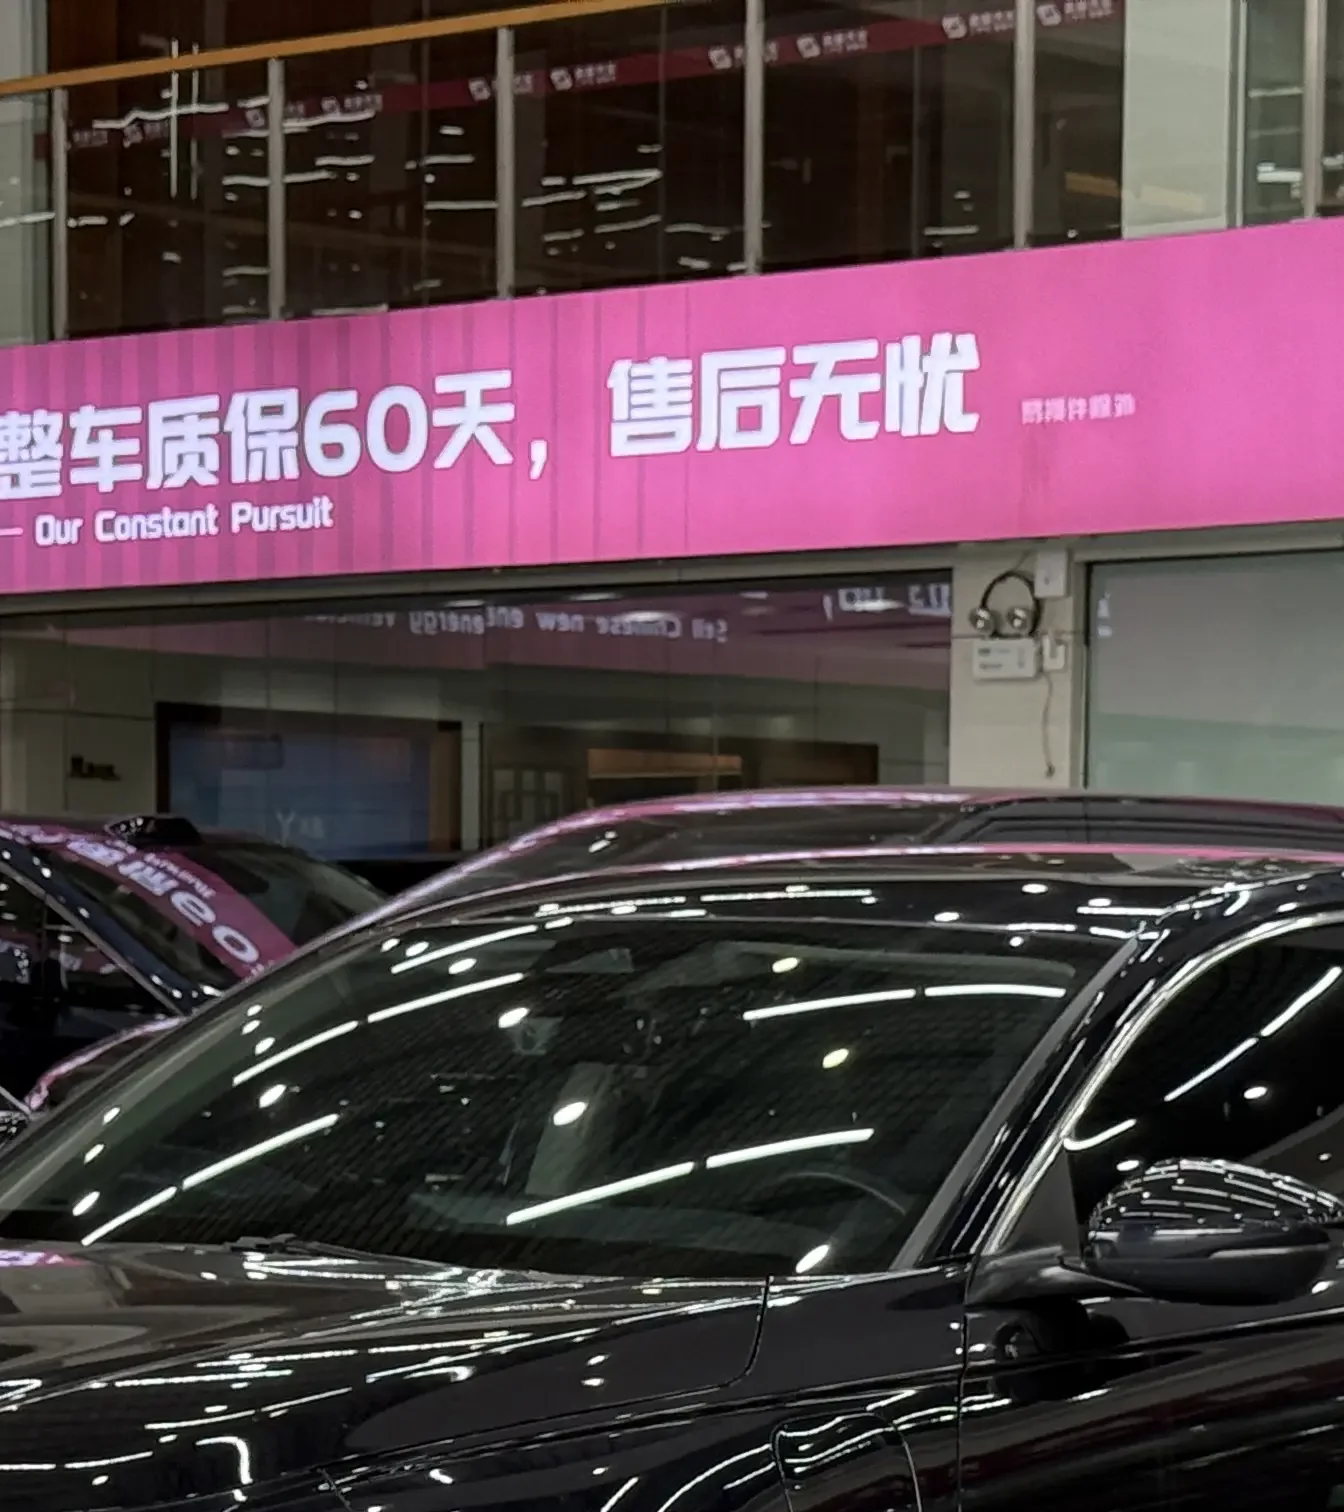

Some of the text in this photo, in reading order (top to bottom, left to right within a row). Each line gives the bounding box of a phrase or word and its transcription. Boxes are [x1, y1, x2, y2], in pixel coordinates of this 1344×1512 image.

[34, 514, 83, 546] Our
[94, 503, 220, 543] Constant
[230, 495, 334, 534] Pursuit
